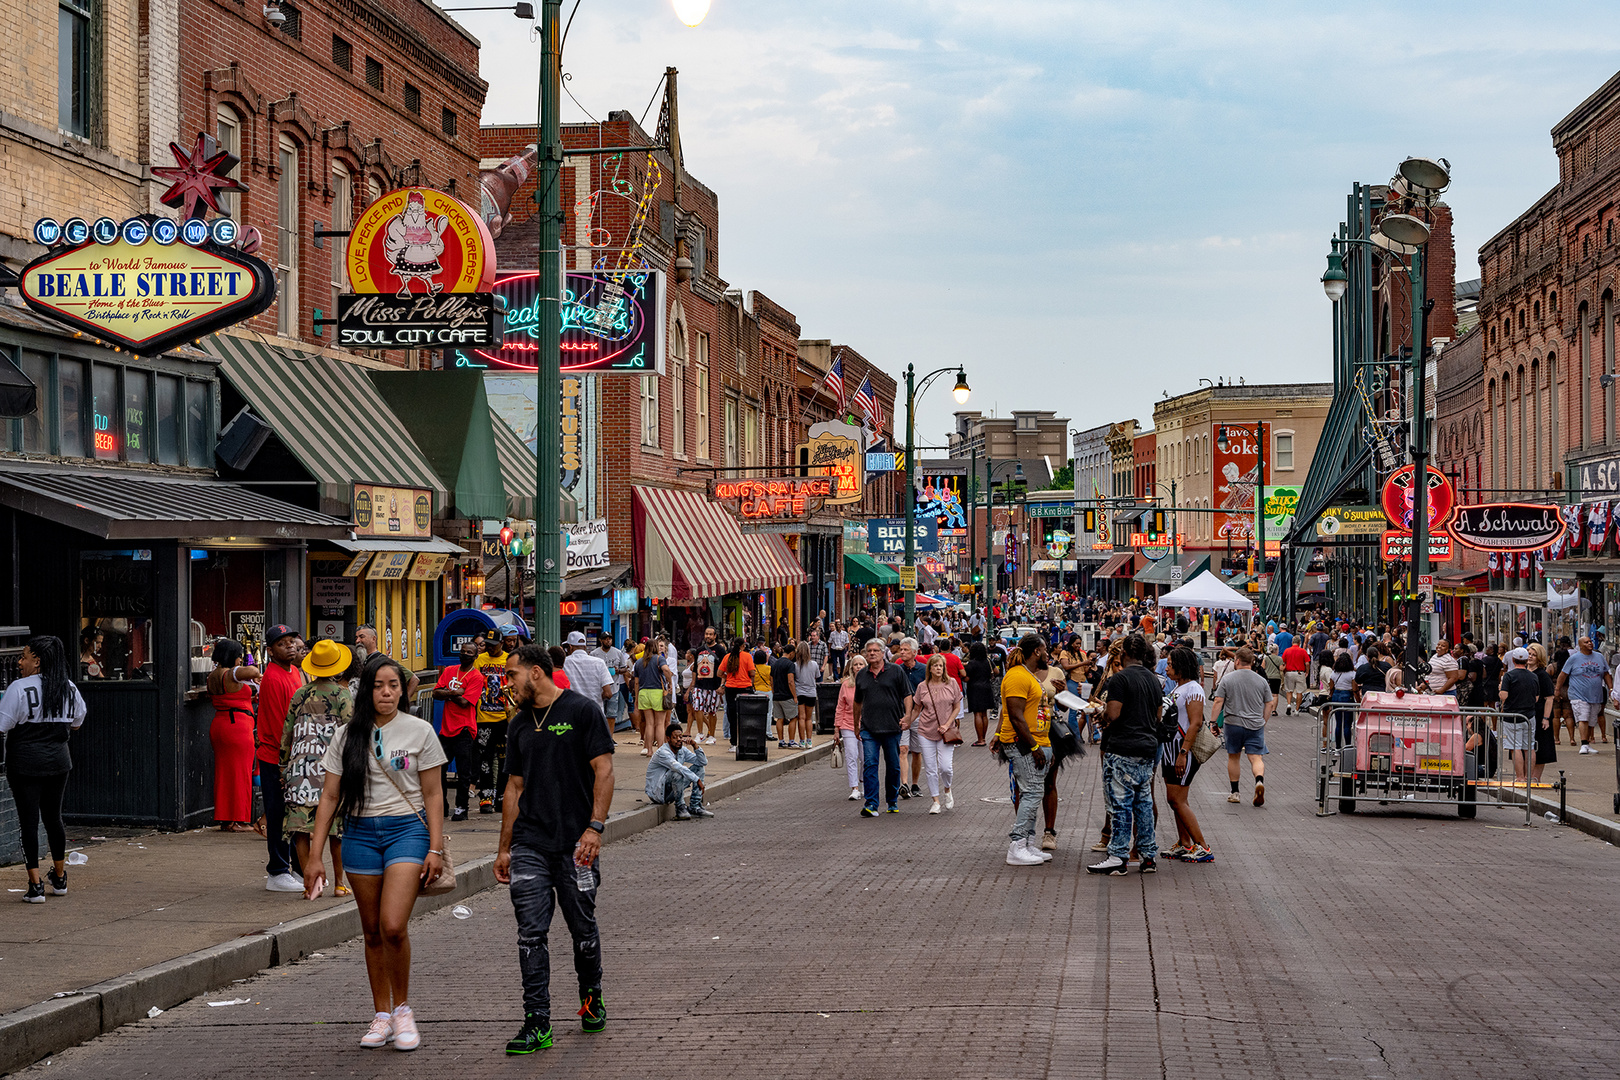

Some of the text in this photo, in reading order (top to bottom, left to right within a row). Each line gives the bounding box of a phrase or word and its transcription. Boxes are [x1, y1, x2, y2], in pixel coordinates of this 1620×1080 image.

[38, 220, 238, 244] WELCOME
[355, 197, 477, 284] LOVE, PEACE AND CHICKEN GREASE
[89, 257, 188, 270] to World Famous
[37, 271, 241, 297] BEALE STREET
[88, 298, 169, 309] Home of the Blues
[341, 296, 407, 323] Miss
[84, 309, 131, 323] Birthplace
[132, 309, 140, 323] of
[341, 329, 487, 344] SOUL CITY CAFE
[562, 379, 579, 471] BLUES
[1223, 426, 1249, 437] Have
[95, 432, 113, 450] BEER
[867, 453, 895, 470] CARGO
[741, 498, 805, 517] CAFE
[1479, 508, 1560, 532] Schwab
[1473, 536, 1540, 546] ESTABLISHED 1876
[390, 553, 408, 566] COLD
[566, 550, 610, 567] BOWLS
[383, 567, 403, 578] BEER
[299, 778, 311, 790] A
